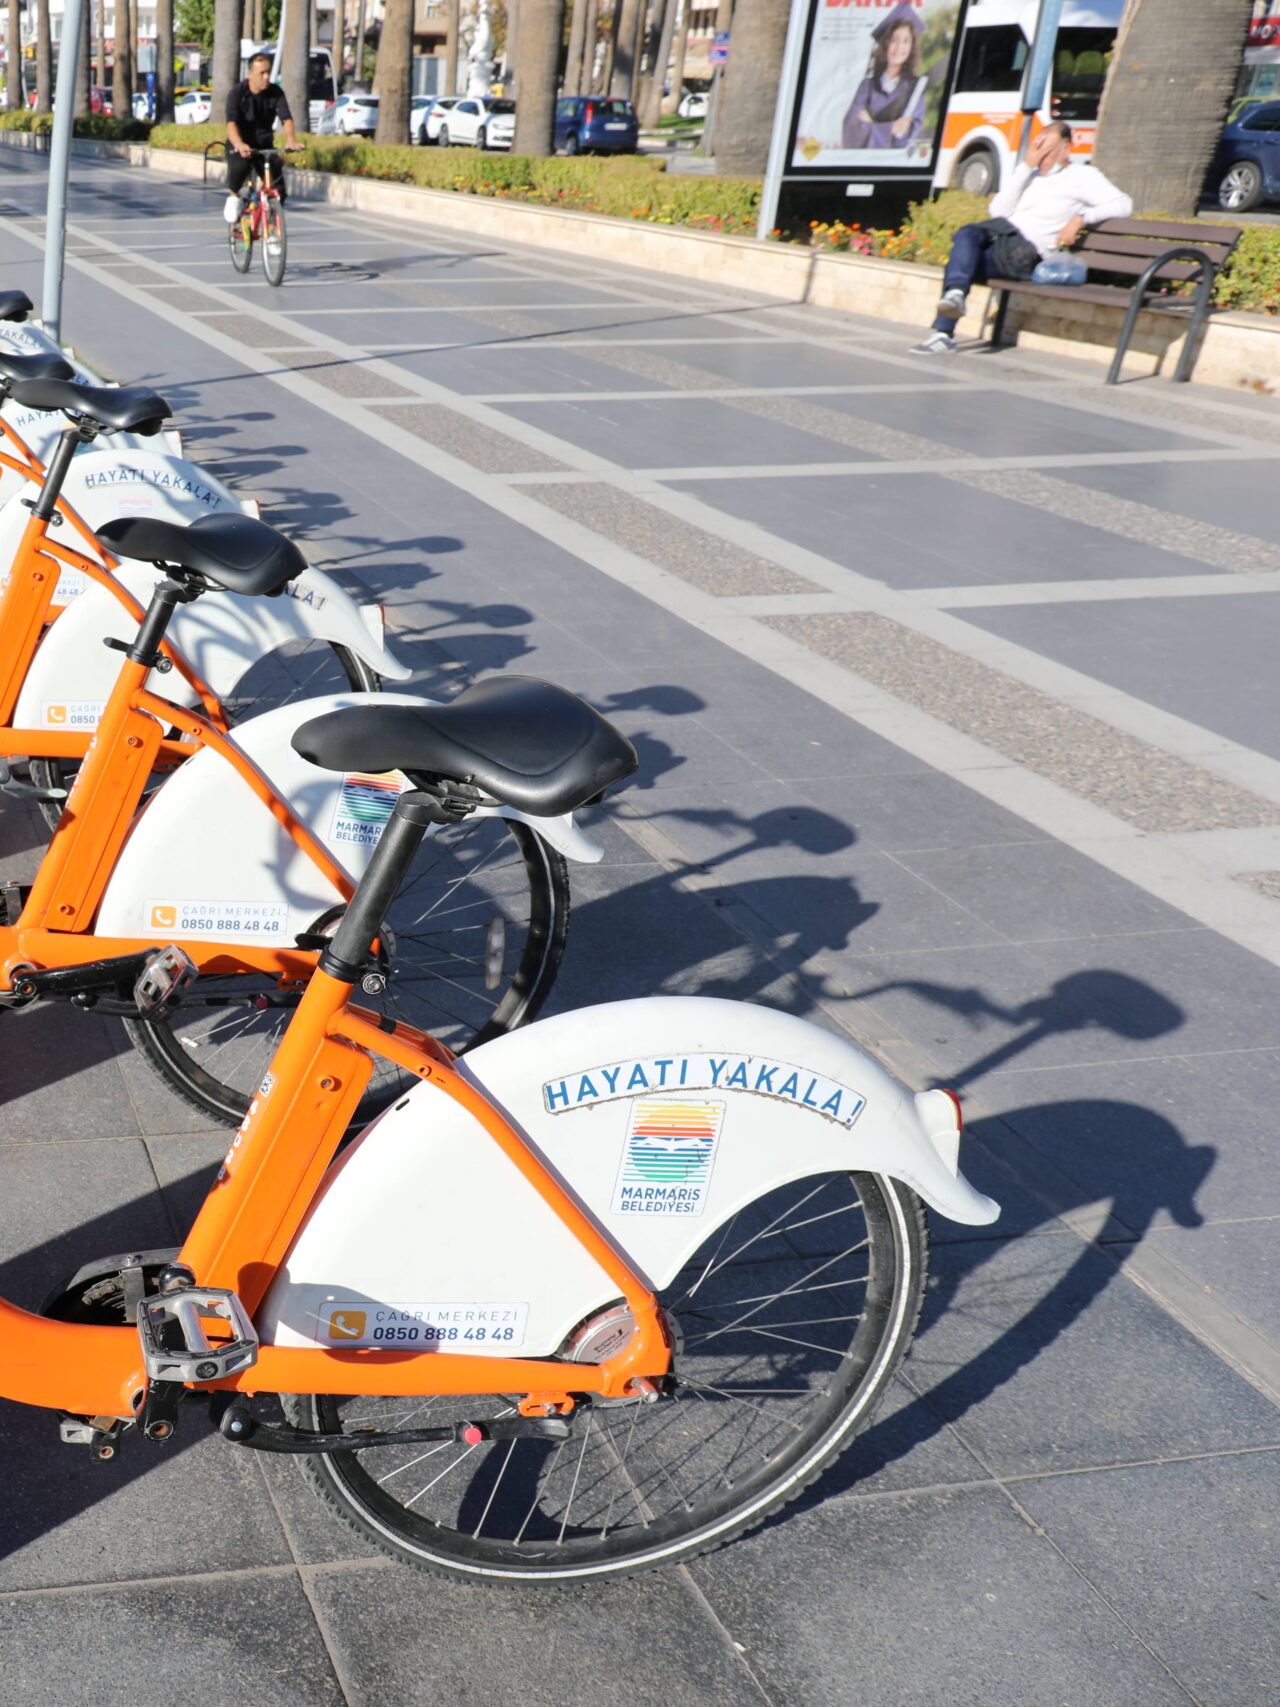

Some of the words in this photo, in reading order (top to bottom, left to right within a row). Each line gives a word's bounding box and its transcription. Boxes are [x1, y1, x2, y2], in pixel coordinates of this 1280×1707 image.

[85, 469, 145, 487] HAYATI
[153, 471, 221, 509] YAKALA!
[70, 715, 96, 724] 0850
[336, 821, 382, 836] MARMAR
[336, 831, 379, 845] BELEDİYE
[181, 919, 213, 930] 0850
[217, 920, 240, 930] 888
[244, 921, 260, 931] 48
[263, 921, 280, 932] 48
[545, 1058, 688, 1110] HAYATI
[709, 1058, 863, 1124] YAKALA!
[621, 1186, 700, 1201] MARMARİS
[621, 1201, 695, 1213] BELEDİYESİ
[375, 1310, 430, 1323] ÇAĞRI
[437, 1310, 518, 1323] MERKEZİ
[373, 1327, 419, 1341] 0850
[424, 1327, 459, 1341] 888
[463, 1327, 486, 1341] 48
[491, 1327, 514, 1341] 48
